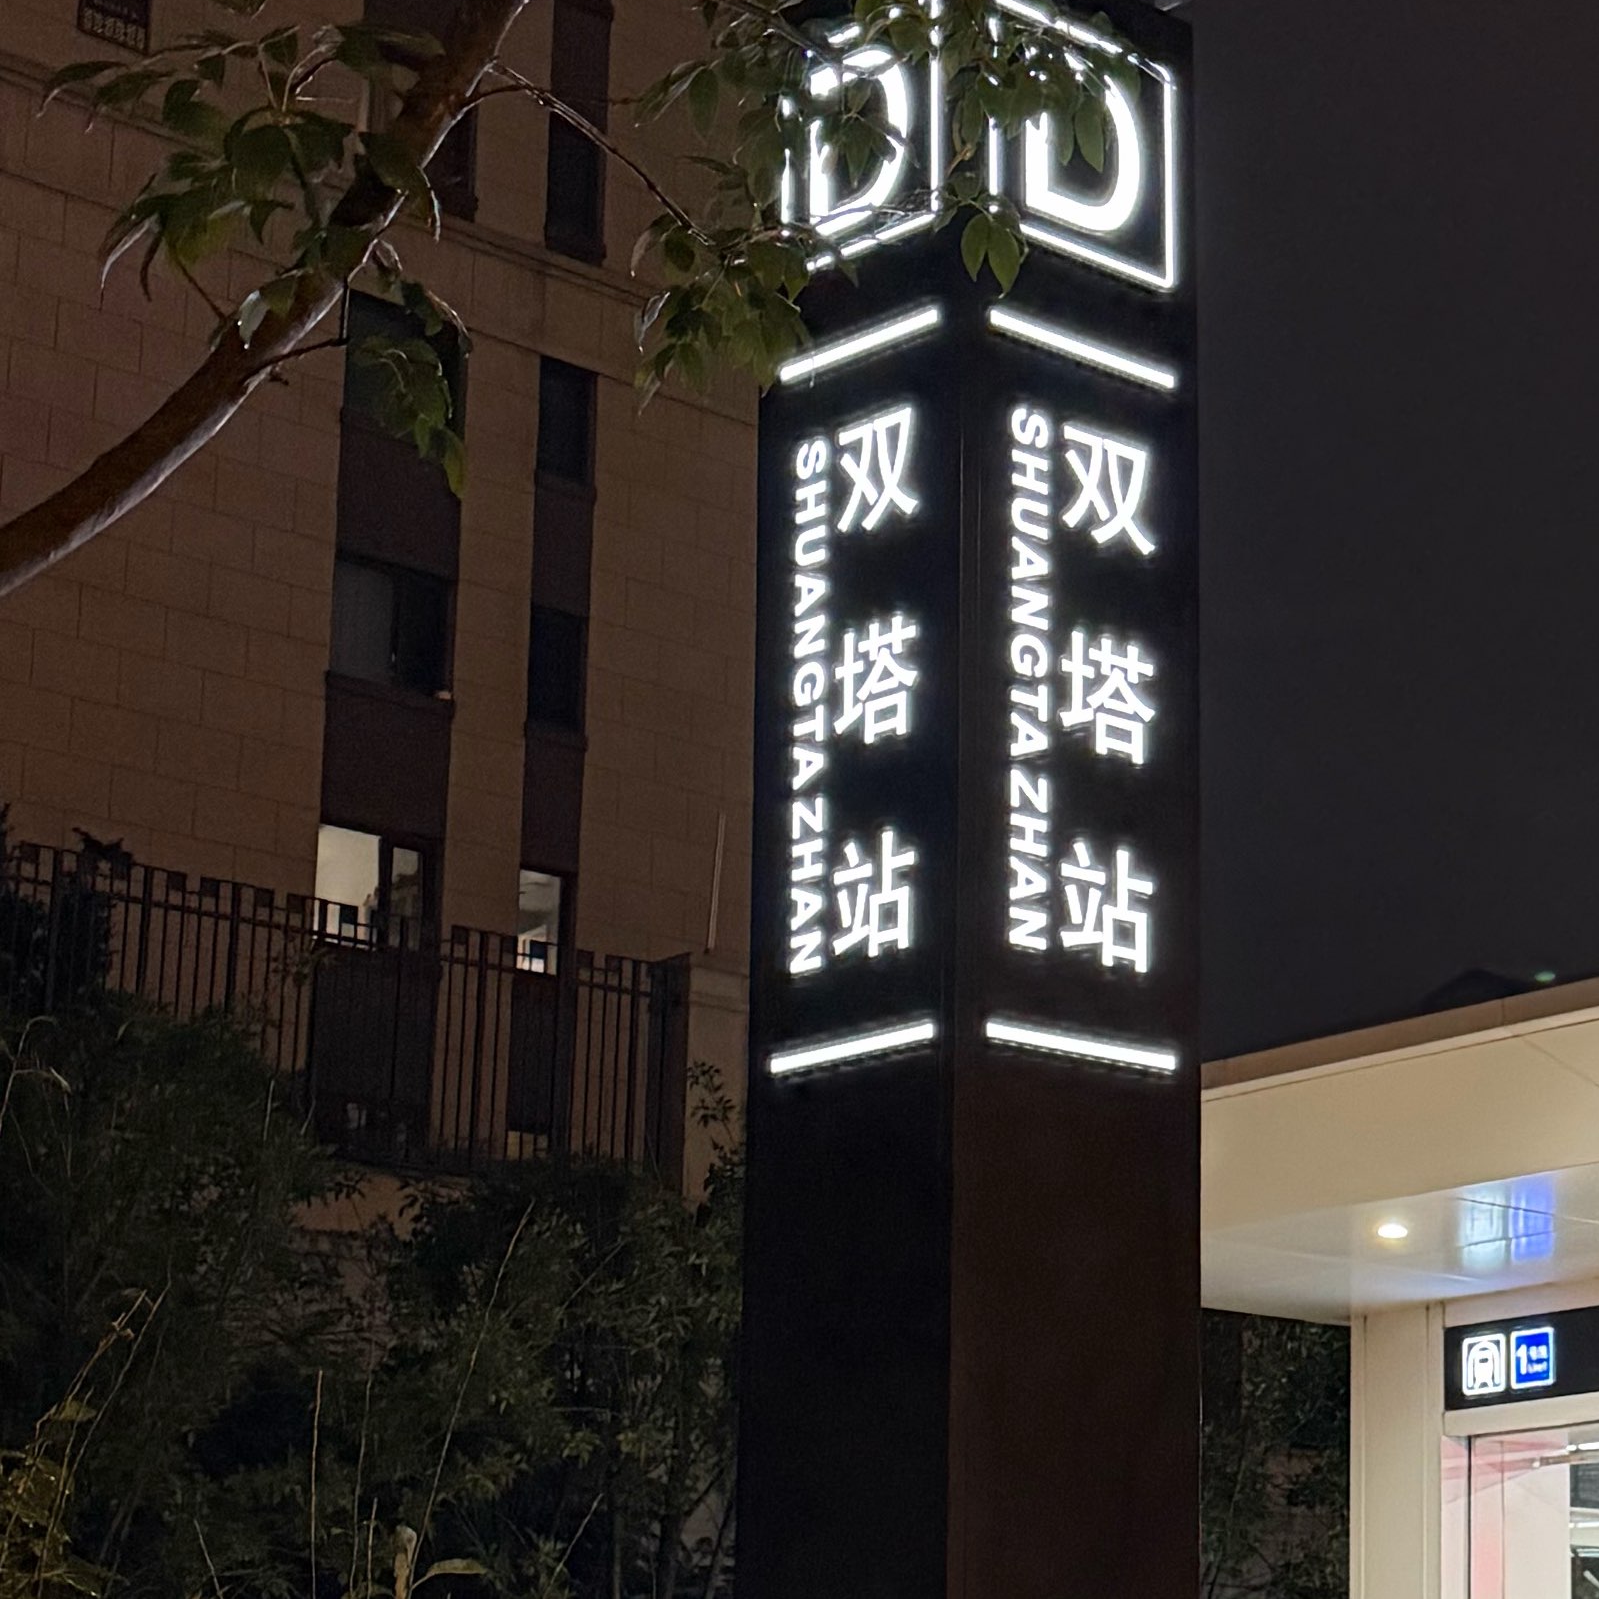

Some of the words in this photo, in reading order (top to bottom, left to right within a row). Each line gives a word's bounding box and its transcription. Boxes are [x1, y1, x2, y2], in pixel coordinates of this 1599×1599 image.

[1025, 46, 1141, 231] D
[832, 406, 919, 958] 双塔站
[1059, 422, 1157, 973] 双塔站
